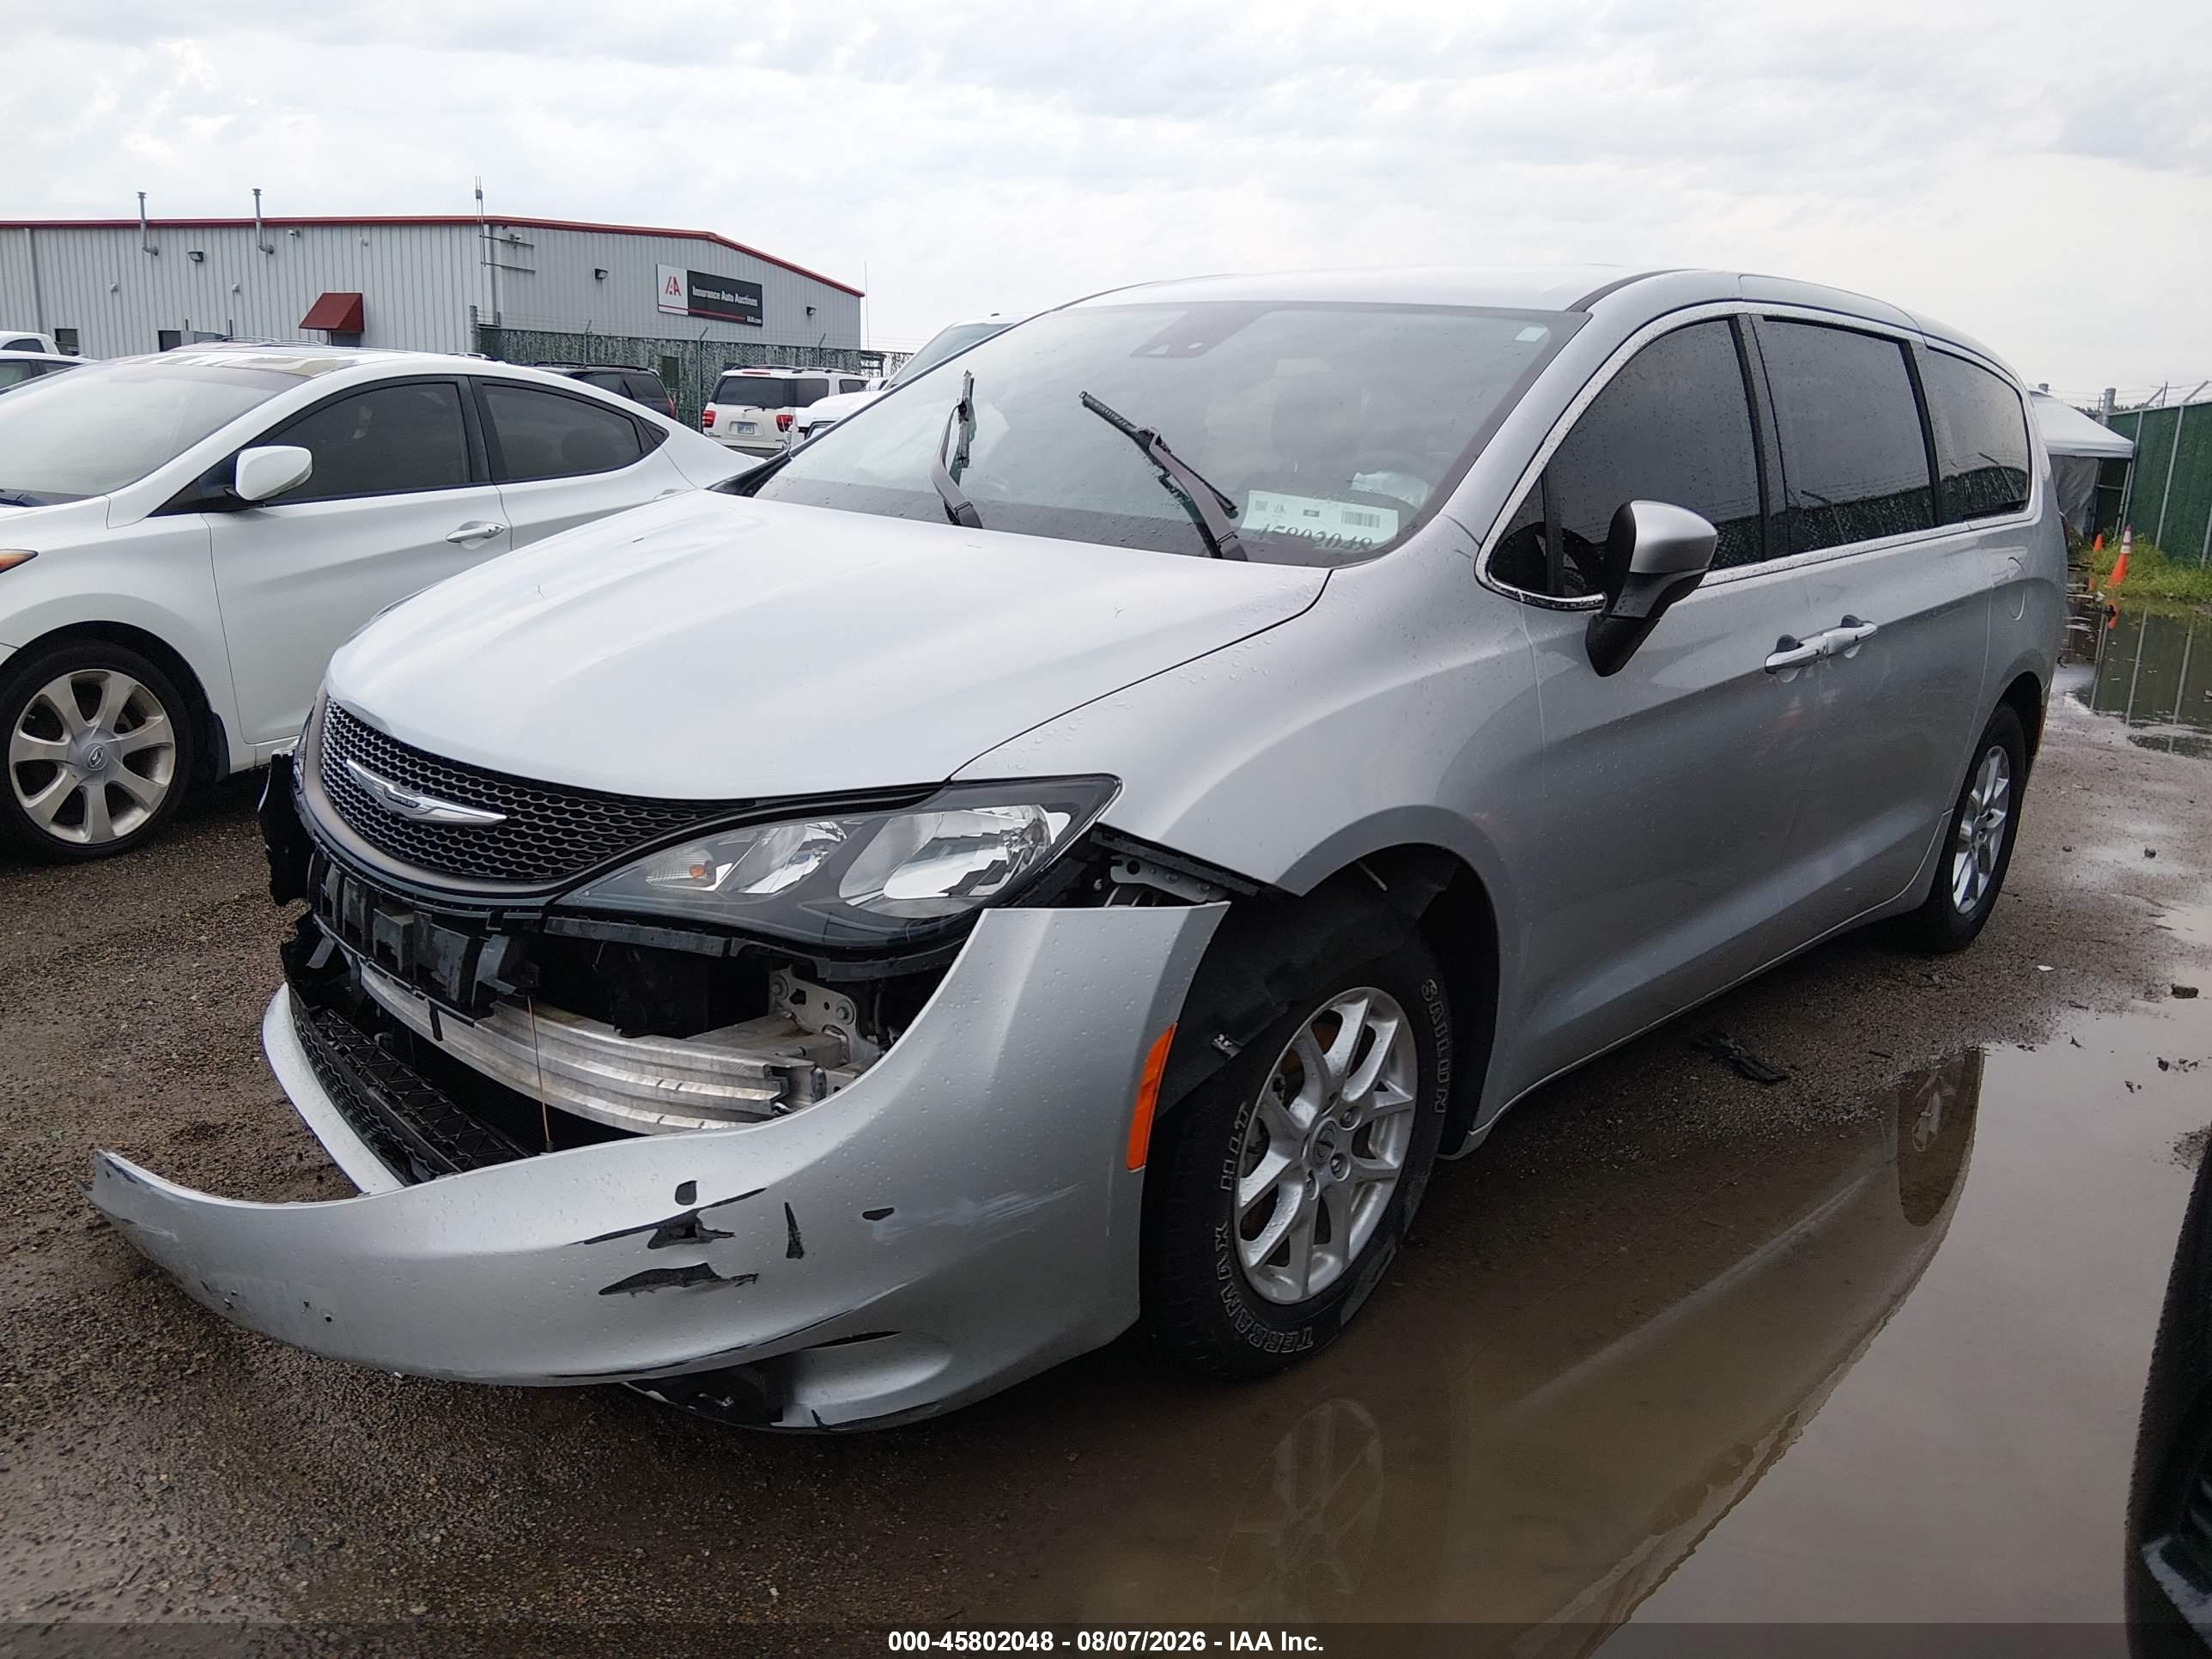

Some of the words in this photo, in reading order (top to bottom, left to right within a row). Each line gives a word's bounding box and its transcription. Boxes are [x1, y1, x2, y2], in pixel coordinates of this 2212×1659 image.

[692, 284, 721, 300] Insurance
[721, 290, 734, 302] Auto
[735, 293, 758, 307] Auctions
[1421, 978, 1451, 1114] SAILUN
[1215, 1220, 1314, 1354] TERRAMAX
